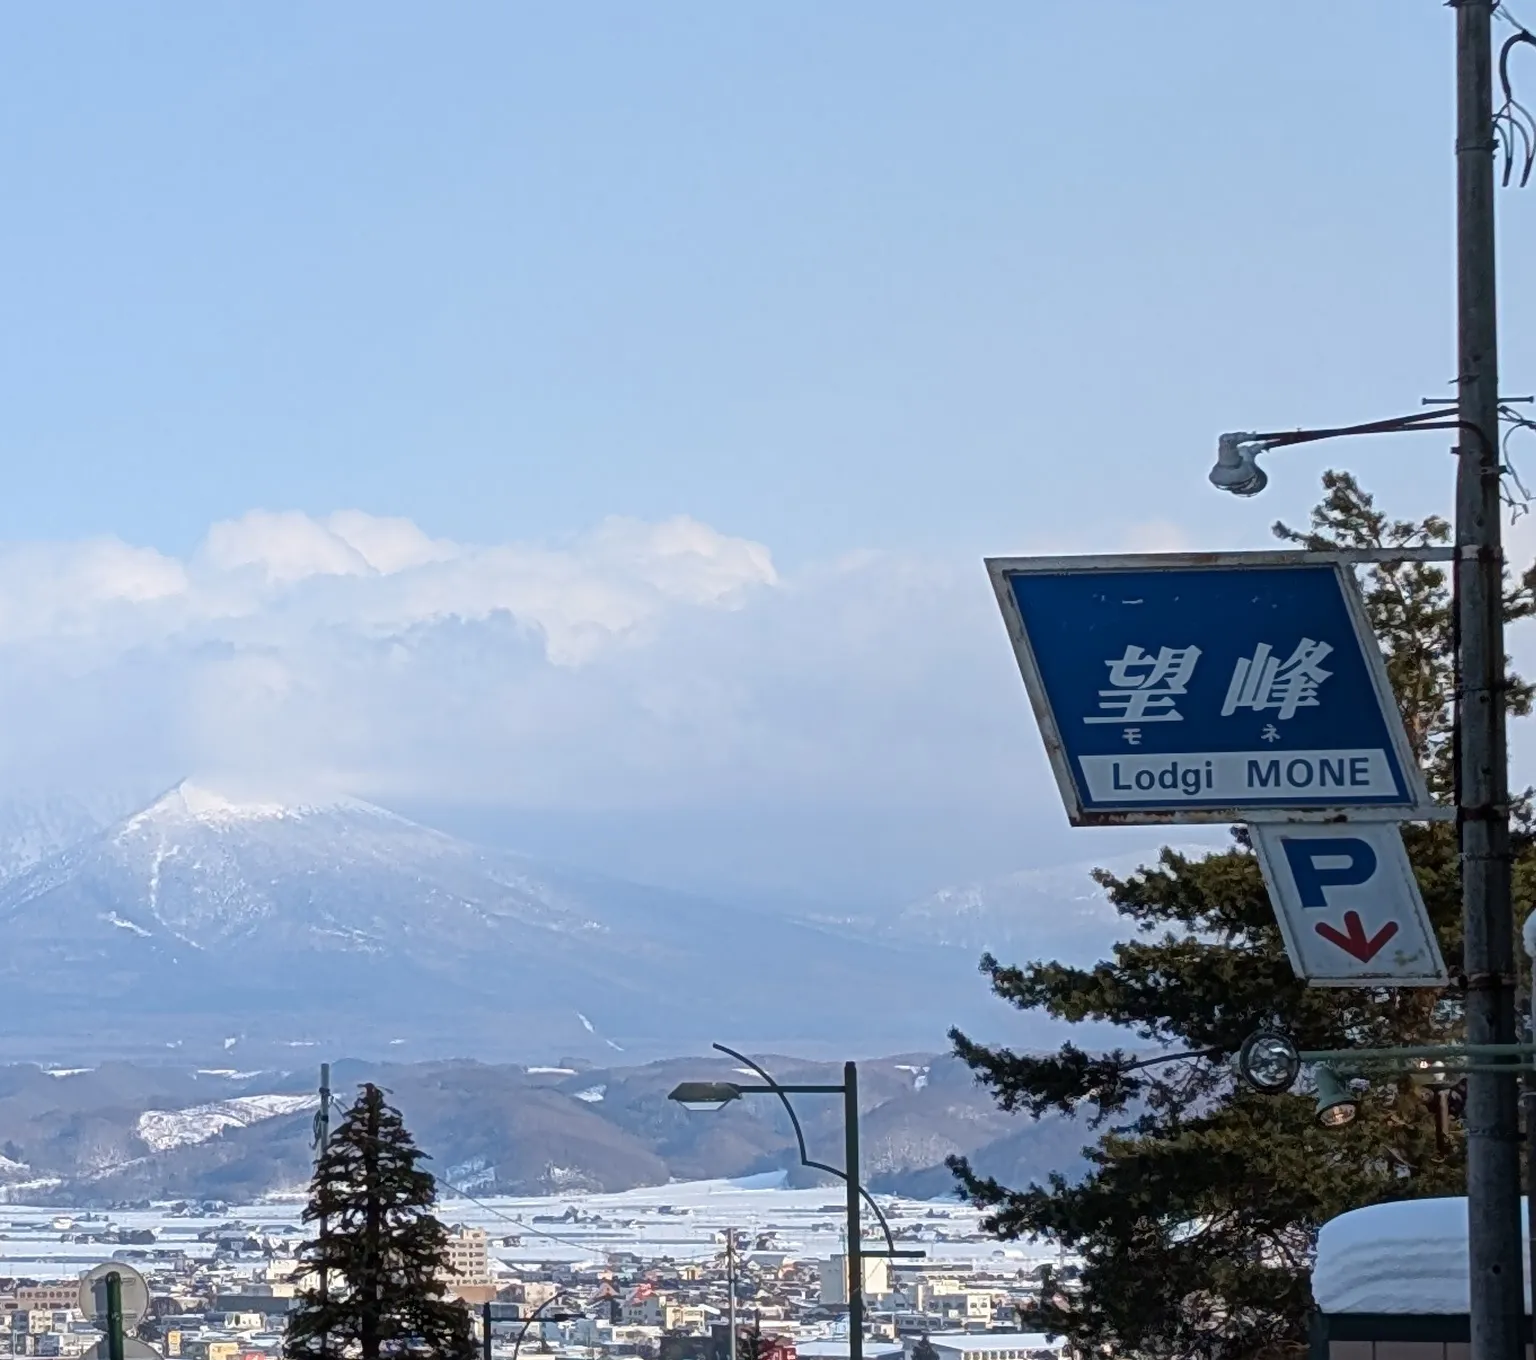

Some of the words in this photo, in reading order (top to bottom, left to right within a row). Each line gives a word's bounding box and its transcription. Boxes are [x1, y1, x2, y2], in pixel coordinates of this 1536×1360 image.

[1083, 637, 1334, 724] 望峰
[1111, 760, 1213, 796] Lodgi
[1246, 757, 1371, 790] MONE
[1279, 837, 1378, 908] P
